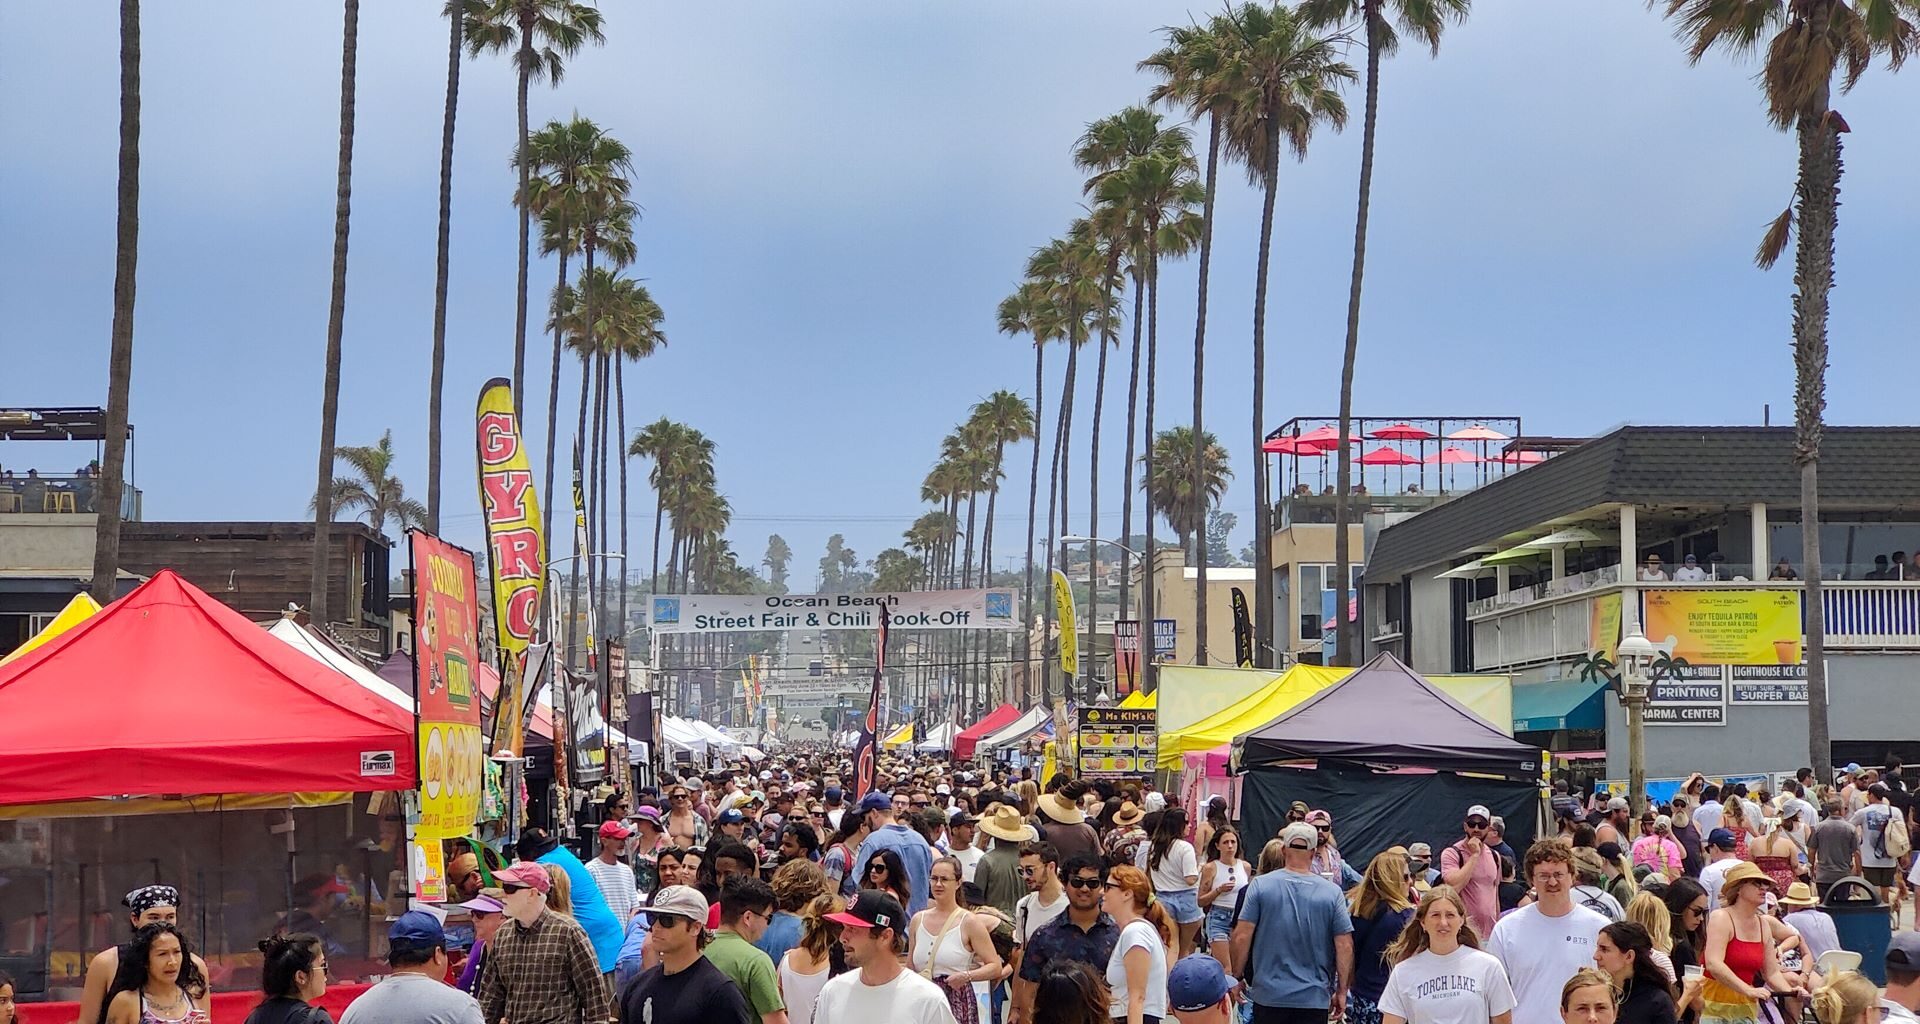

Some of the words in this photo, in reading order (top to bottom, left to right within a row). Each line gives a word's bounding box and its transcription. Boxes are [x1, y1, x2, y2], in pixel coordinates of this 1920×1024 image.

[479, 412, 541, 639] GYRO
[765, 597, 829, 608] Ocean
[837, 595, 899, 607] Beach
[695, 614, 755, 629] Street
[762, 612, 799, 628] Fair
[805, 612, 820, 627] &
[827, 611, 871, 627] Chili
[889, 611, 970, 626] ook-Off
[1688, 612, 1707, 621] ENJOY
[1708, 612, 1733, 621] TEQUILA
[1734, 611, 1758, 621] PATRÓN
[1117, 623, 1137, 636] HIGH
[1153, 622, 1173, 635] HIGH
[1117, 636, 1138, 650] TIDES
[1154, 635, 1174, 649] TIDES
[1698, 667, 1721, 677] GRILLE
[1734, 666, 1781, 677] LIGHTHOUSE
[1783, 666, 1794, 677] ICE
[1657, 687, 1719, 697] PRINTING
[1741, 691, 1784, 700] SURFER
[1120, 711, 1146, 721] KIM's
[1681, 708, 1720, 719] CENTER
[362, 761, 392, 771] Eurmax
[1417, 974, 1448, 1000] TORCH
[1450, 974, 1476, 994] LAKE
[1431, 991, 1461, 1000] MICHIGAN
